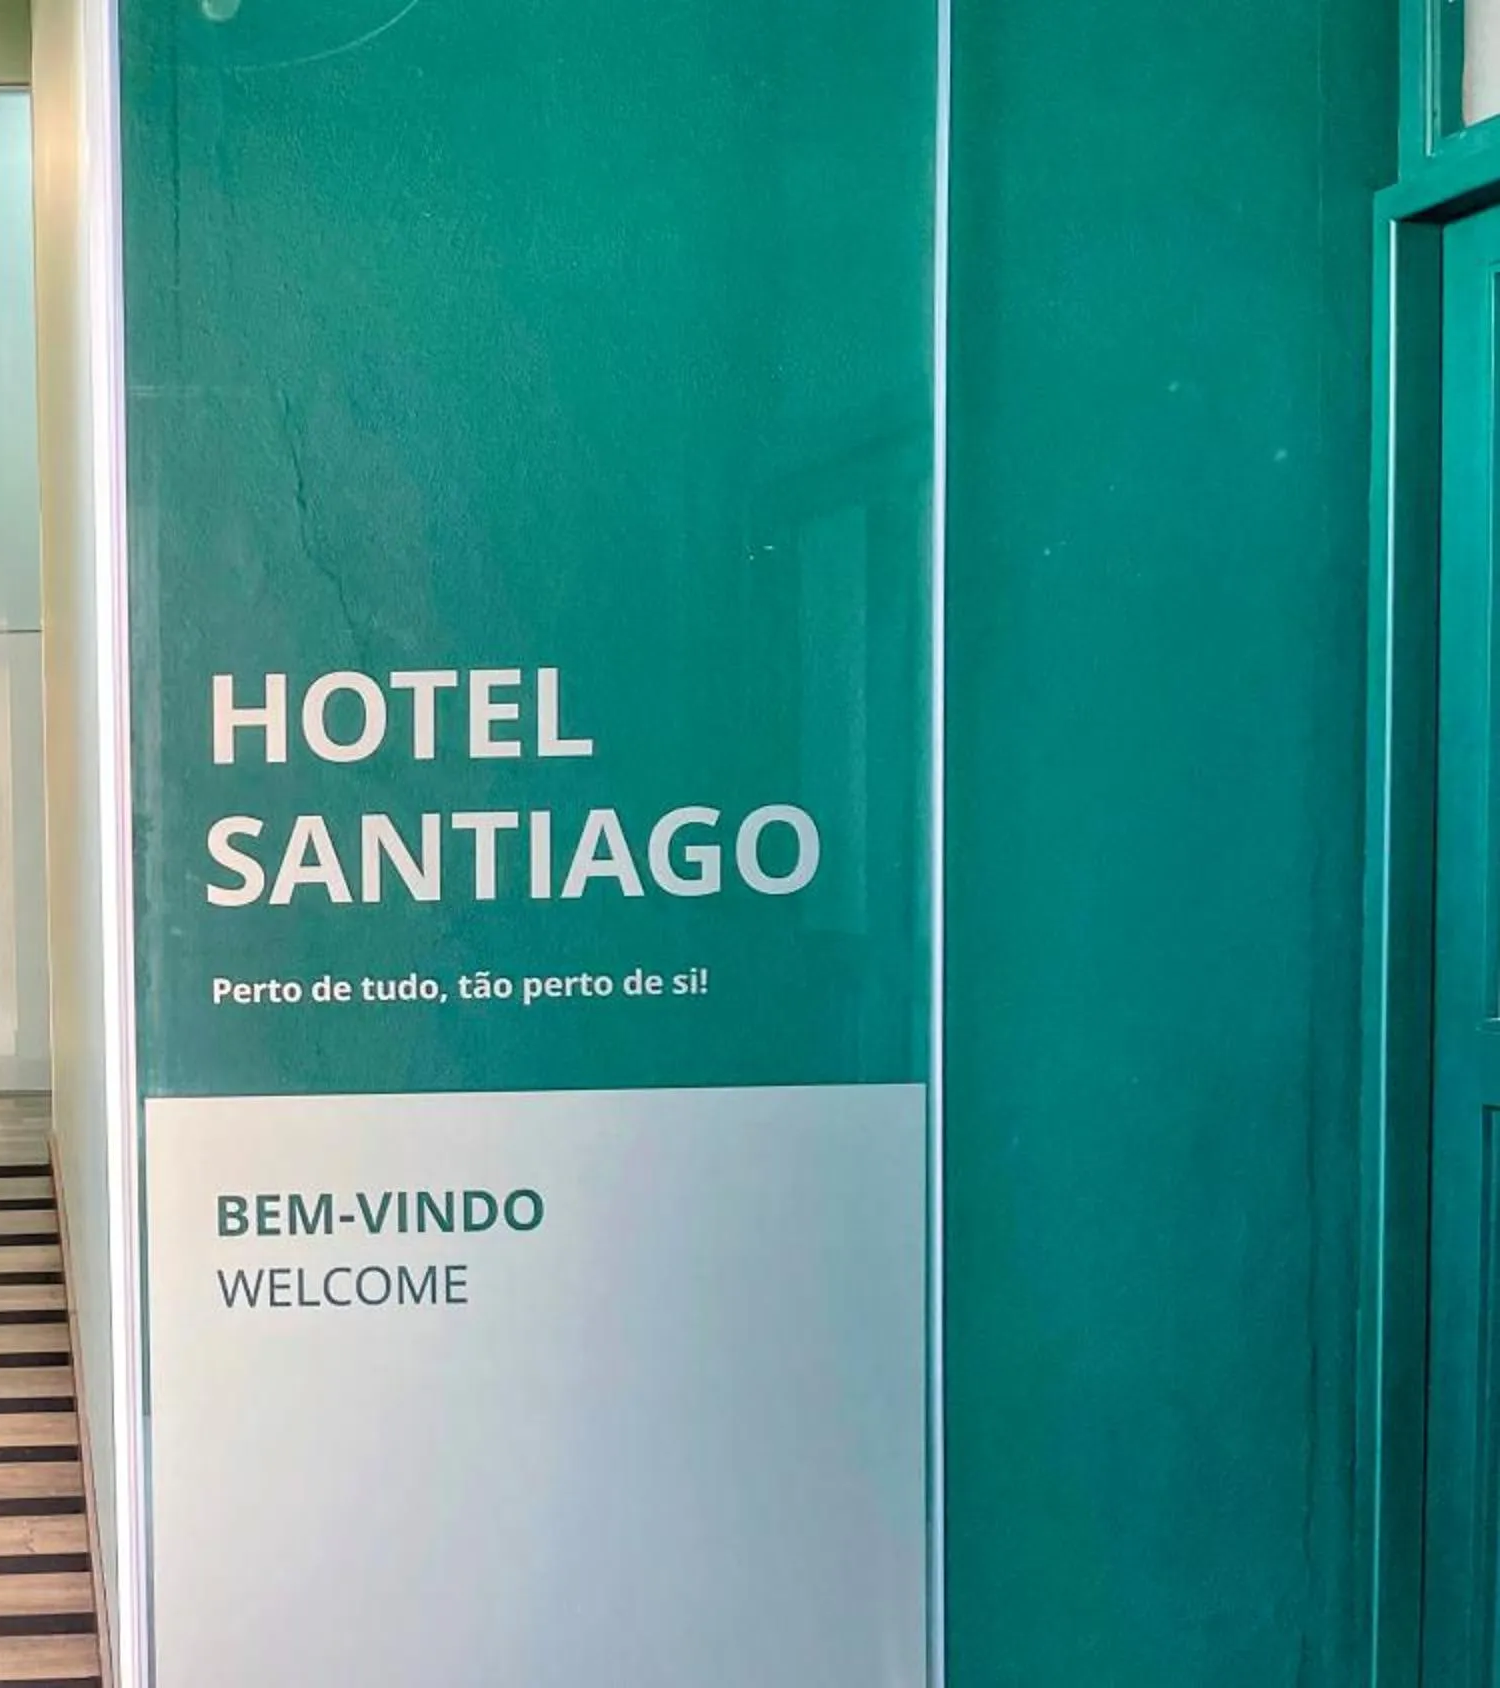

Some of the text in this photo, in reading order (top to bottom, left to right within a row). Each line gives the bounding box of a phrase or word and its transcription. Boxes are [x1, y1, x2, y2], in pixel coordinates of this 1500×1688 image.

[212, 667, 593, 764] HOTEL
[206, 804, 821, 906] SANTIAGO
[213, 968, 708, 1004] Perto de tudo, tão perto de si!
[218, 1189, 544, 1236] BEM-VINDO
[218, 1265, 468, 1307] WELCOME
